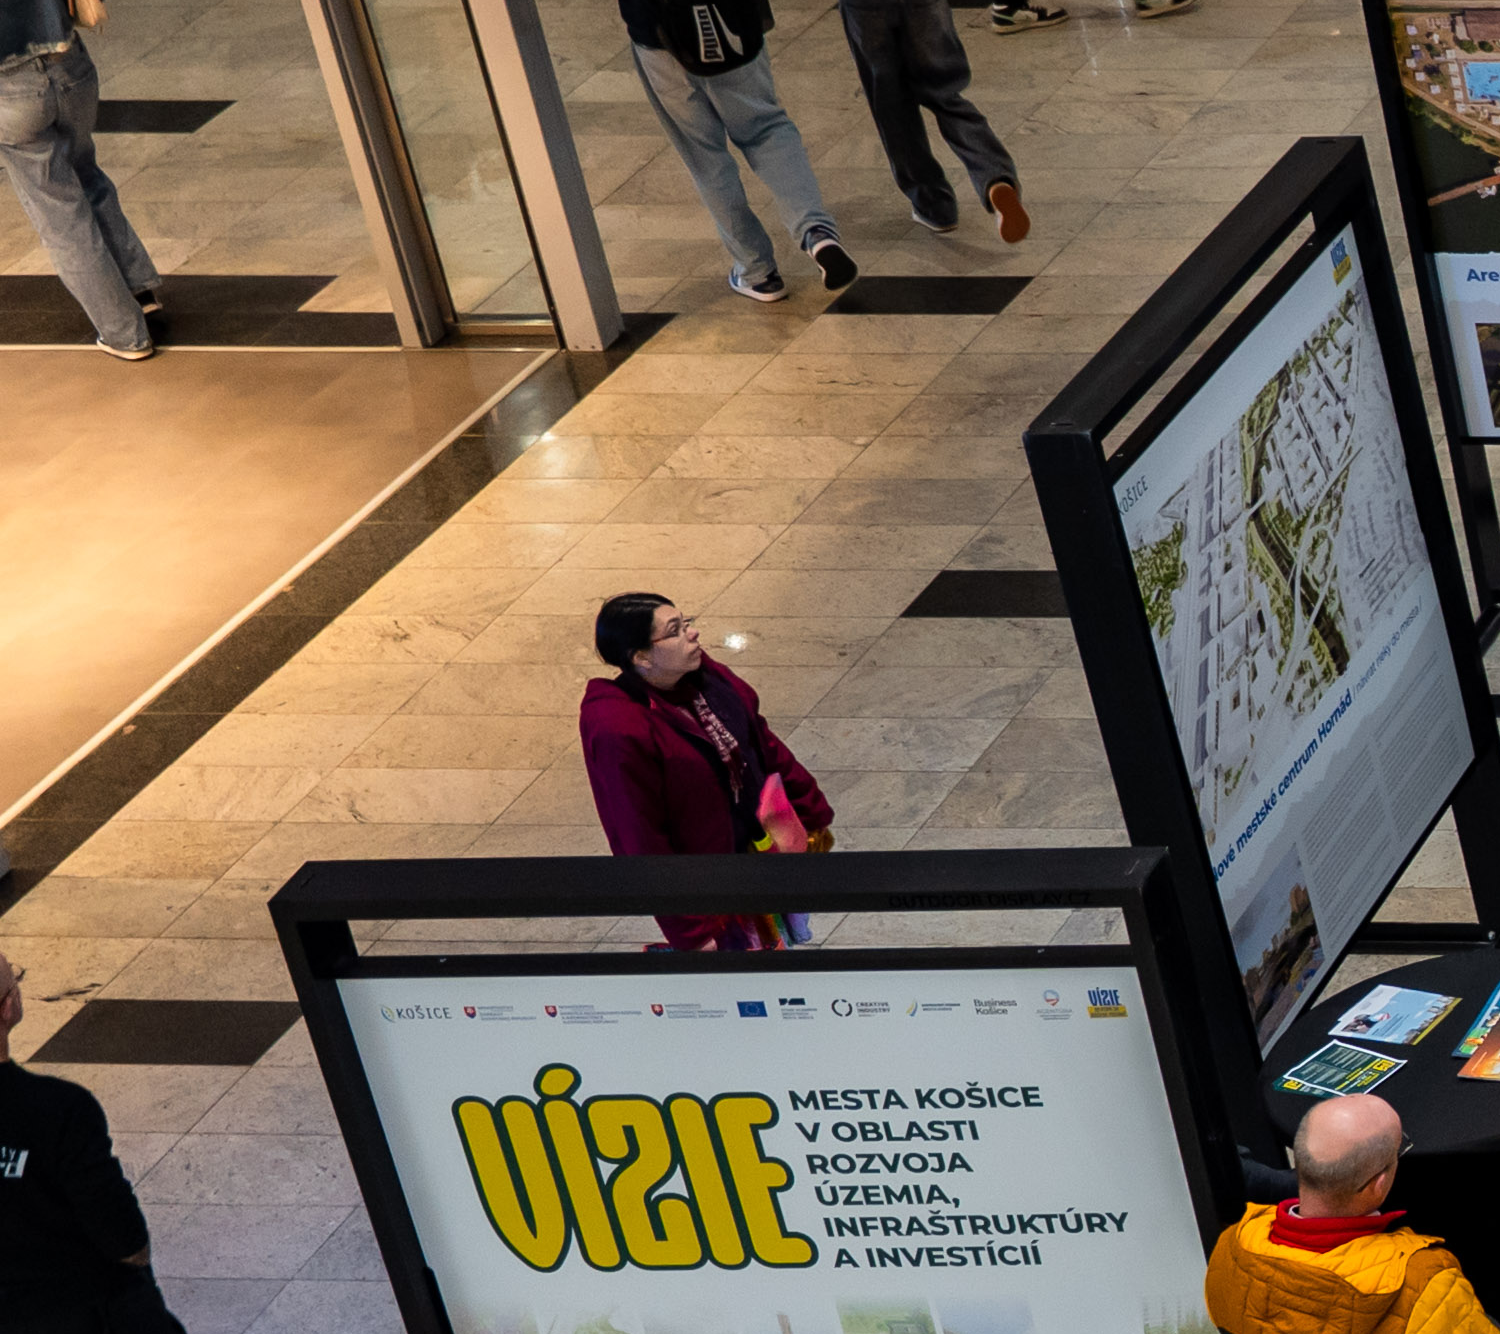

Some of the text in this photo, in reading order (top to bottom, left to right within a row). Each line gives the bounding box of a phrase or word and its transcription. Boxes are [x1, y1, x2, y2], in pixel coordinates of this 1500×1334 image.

[1236, 786, 1278, 854] mestské
[1277, 737, 1319, 796] centrum
[1317, 688, 1353, 743] Hornád
[396, 1005, 453, 1021] KOŠICE
[788, 1081, 1044, 1111] MESTA KOŠICE
[795, 1119, 980, 1143] V OBLASTI
[805, 1152, 974, 1175] ROZVOJA
[814, 1179, 961, 1209] ÚZEMIA,
[823, 1207, 1129, 1238] INFRAŠTRUKTÚRY
[834, 1239, 1043, 1269] A INVESTÍCIÍ
